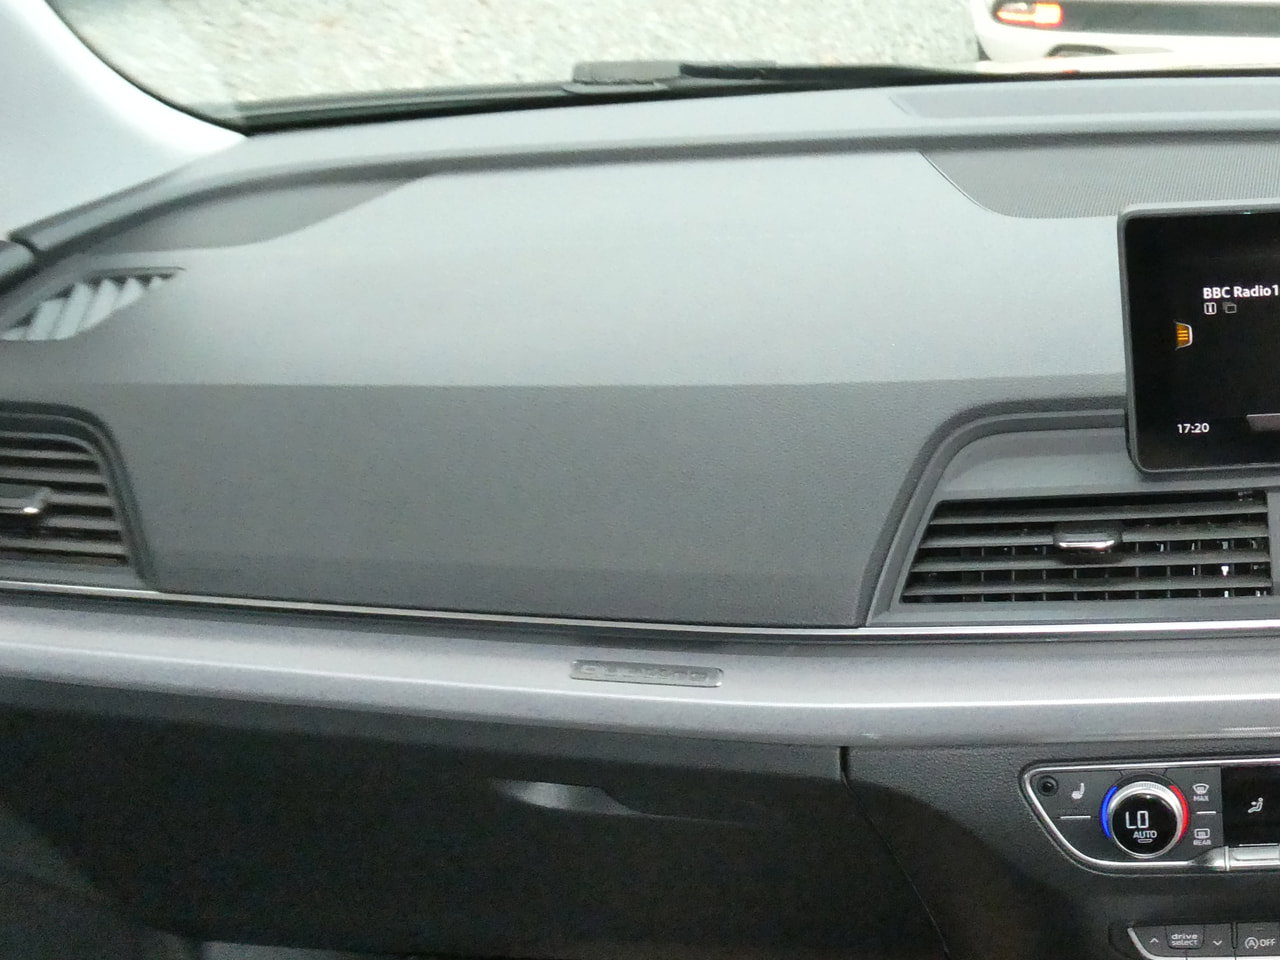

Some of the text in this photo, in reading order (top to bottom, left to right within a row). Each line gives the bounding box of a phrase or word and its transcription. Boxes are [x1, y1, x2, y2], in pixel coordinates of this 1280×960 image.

[1203, 287, 1231, 299] BBC
[1176, 422, 1210, 434] 17:20
[1132, 830, 1158, 839] AUTO
[1171, 932, 1198, 941] drive
[1171, 939, 1198, 947] select
[1259, 938, 1276, 947] OFF
